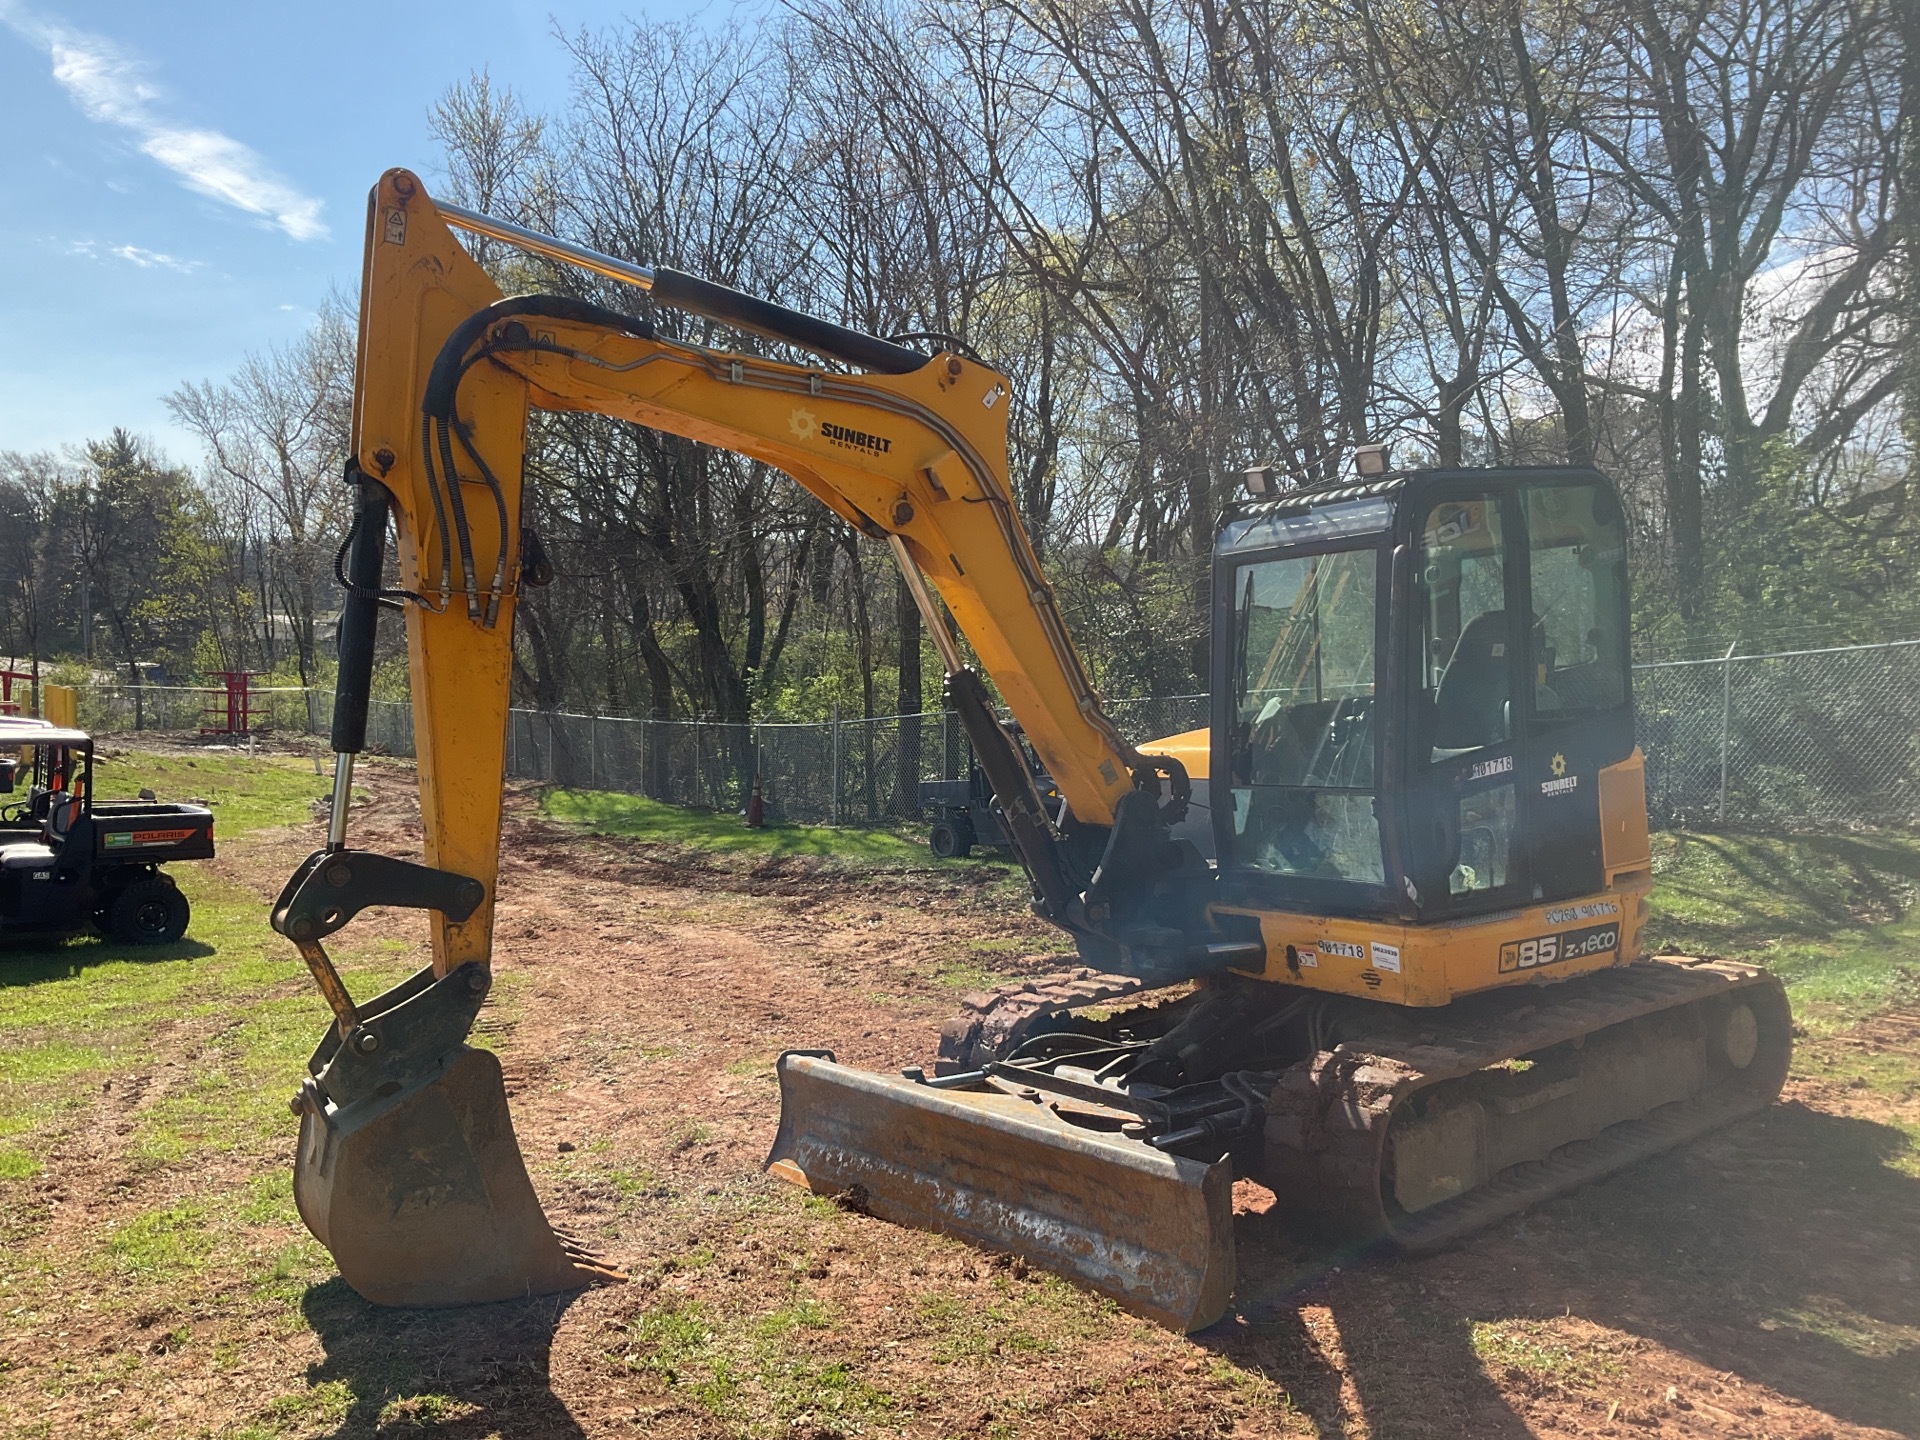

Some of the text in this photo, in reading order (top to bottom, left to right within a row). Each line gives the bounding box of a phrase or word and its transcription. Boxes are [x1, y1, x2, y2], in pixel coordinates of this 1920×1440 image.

[820, 422, 891, 453] SUNBELT
[830, 439, 880, 457] RENTALS
[1541, 776, 1577, 793] SUNBELT
[1547, 788, 1573, 797] RENTALS
[133, 831, 185, 840] POLARIS
[1318, 940, 1364, 958] 901718
[1519, 937, 1556, 967] 85
